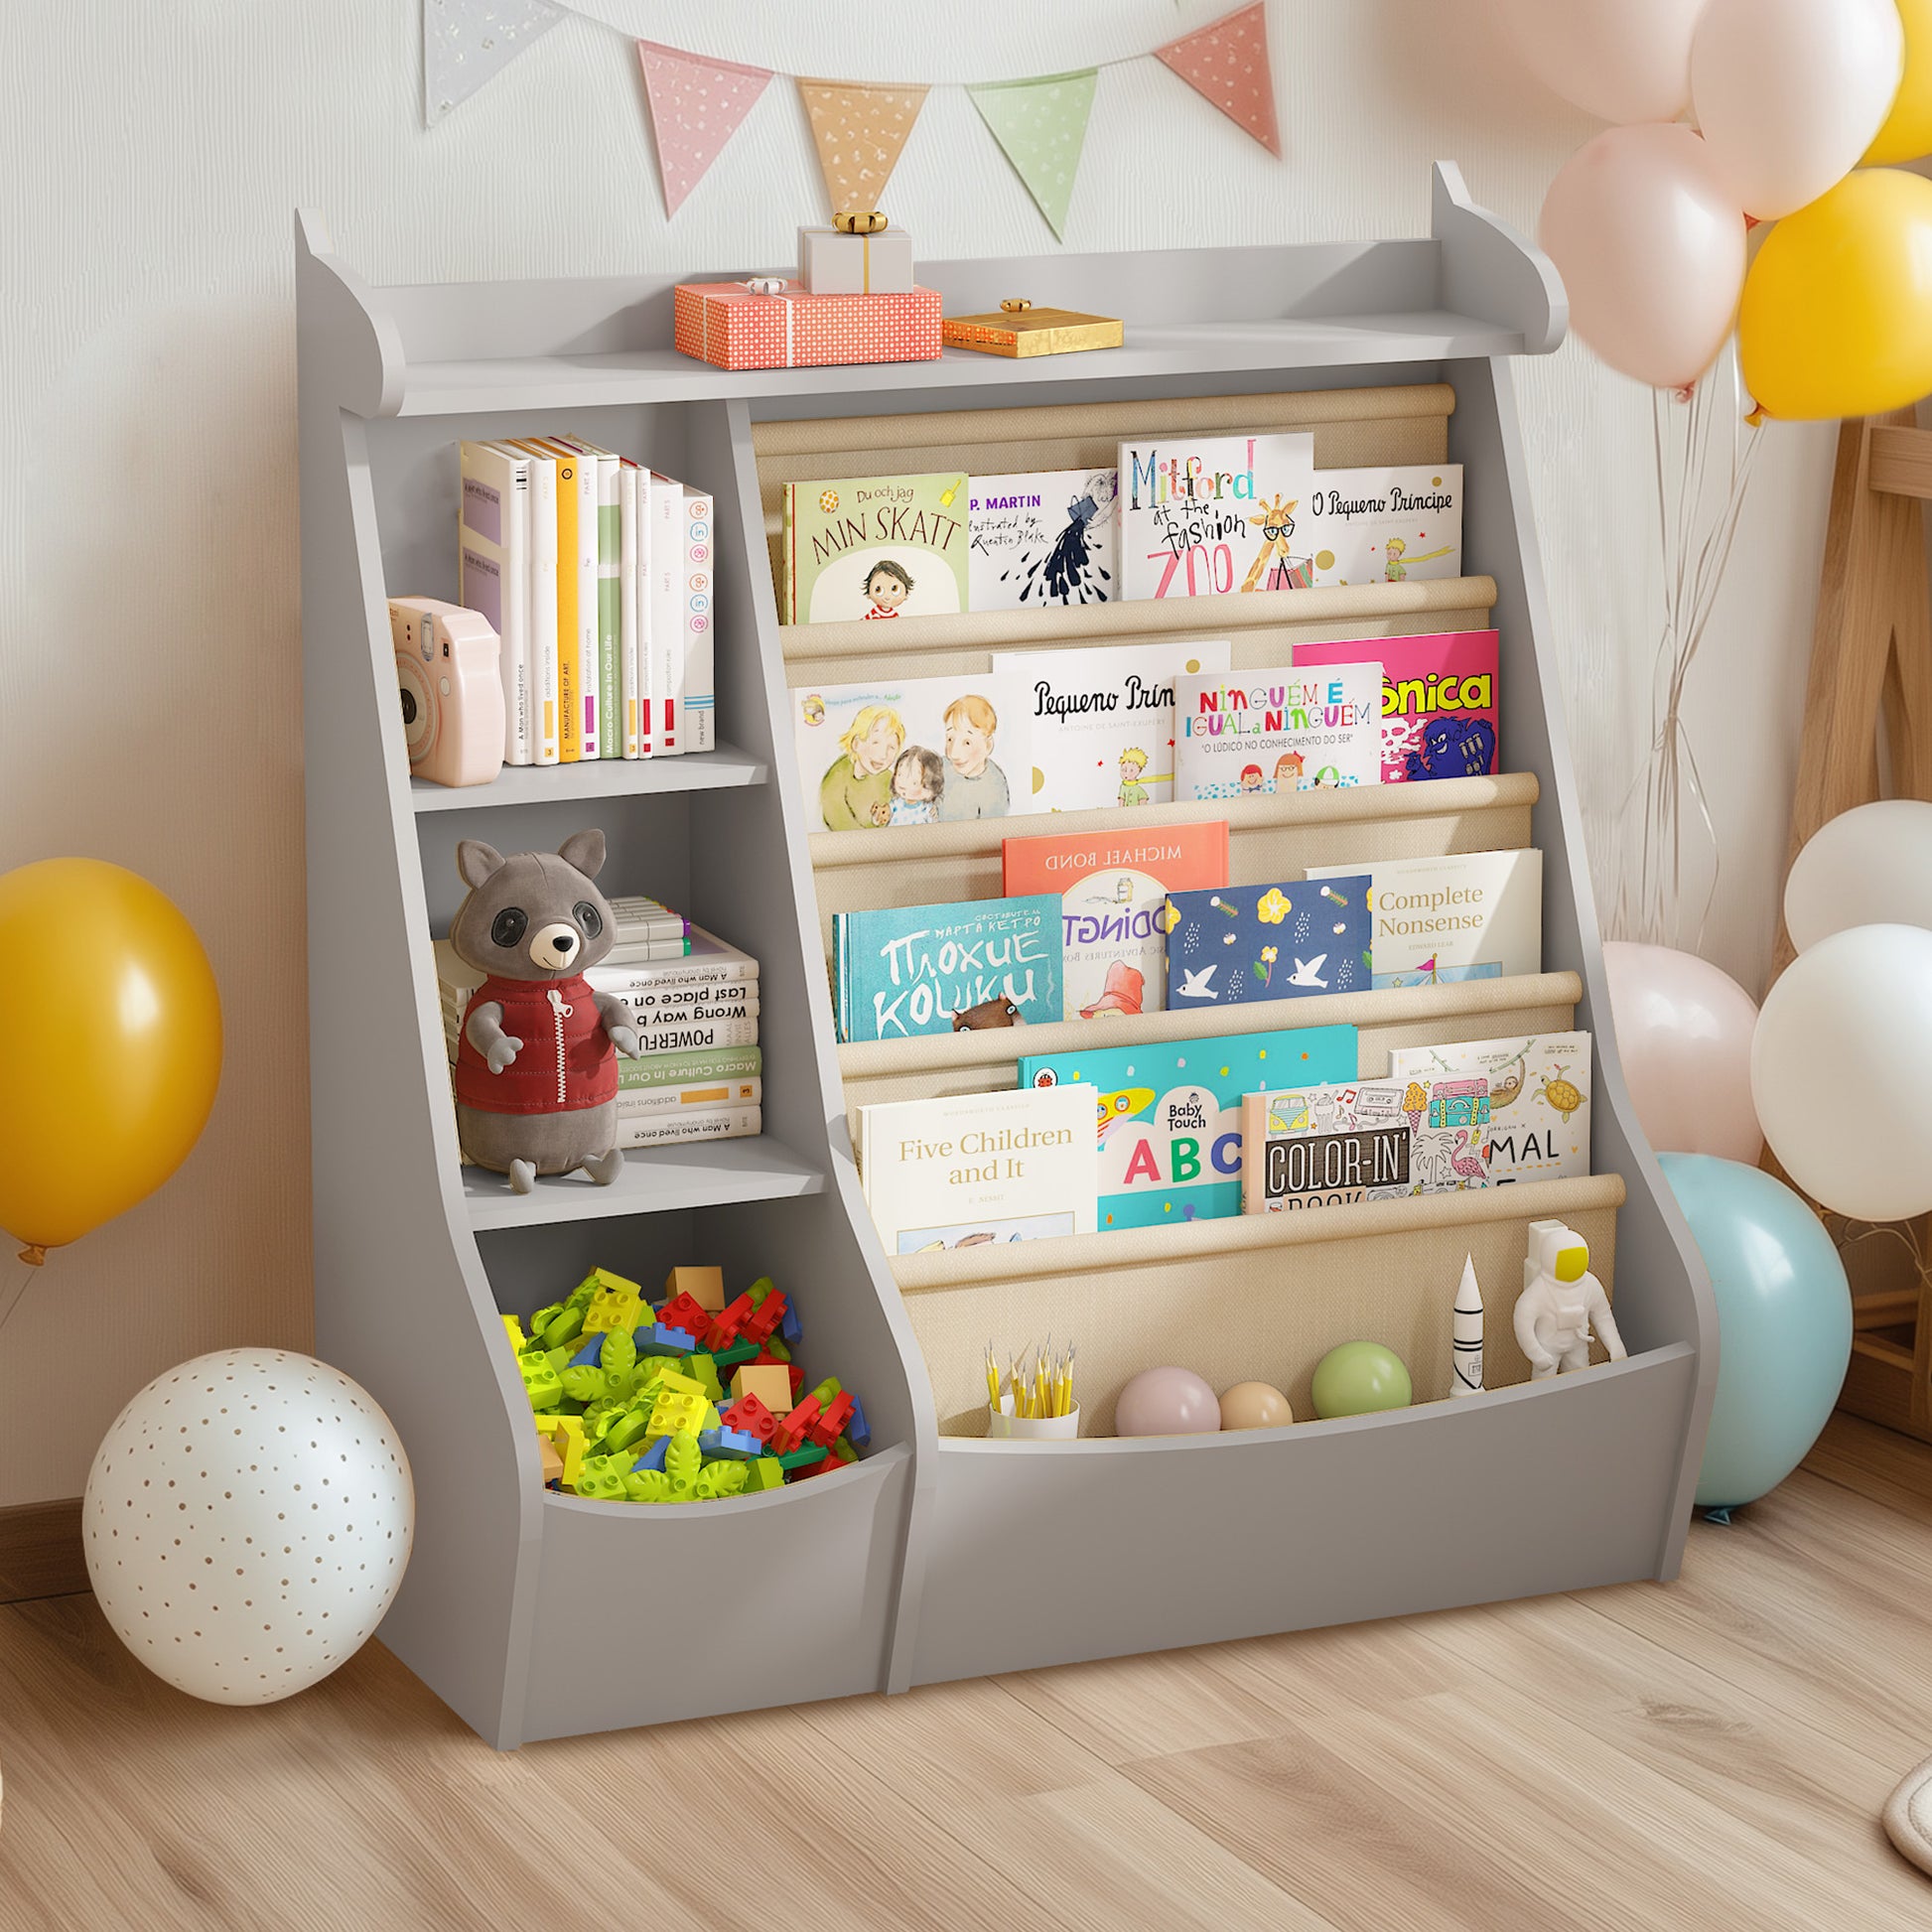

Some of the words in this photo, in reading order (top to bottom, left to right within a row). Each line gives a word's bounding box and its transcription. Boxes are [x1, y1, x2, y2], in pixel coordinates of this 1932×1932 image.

[1130, 439, 1257, 511] Mitford
[857, 487, 872, 503] Du
[874, 485, 895, 498] och
[891, 485, 914, 502] jag
[969, 498, 981, 510] P.
[986, 494, 1041, 510] MARTIN
[1153, 505, 1172, 526] at
[1180, 499, 1210, 519] the
[1312, 491, 1324, 516] O
[1328, 488, 1387, 521] Pequeno
[812, 513, 867, 565] MIN
[875, 506, 961, 552] SKATT
[1161, 510, 1247, 559] fashion
[1147, 543, 1234, 600] ZOO
[604, 634, 613, 650] Life
[604, 653, 613, 671] Our
[563, 677, 570, 687] OF
[605, 673, 613, 683] In
[605, 684, 614, 720] Culture
[1034, 680, 1119, 724] Pequeno
[1095, 722, 1107, 731] DE
[1185, 712, 1251, 738] IGUAL
[1252, 723, 1262, 735] a
[1245, 740, 1258, 751] NO
[1261, 735, 1321, 750] CONHECIMENTO
[1323, 735, 1336, 745] DO
[1379, 886, 1483, 911] Complete
[934, 922, 983, 939] МАРТА
[988, 916, 1041, 932] КЕТРО
[1379, 913, 1483, 936] Nonsense
[629, 980, 653, 989] once
[654, 977, 676, 987] lived
[677, 975, 697, 985] who
[699, 974, 719, 983] Man
[634, 996, 655, 1007] on
[661, 987, 709, 1006] place
[714, 987, 747, 1002] Last
[636, 1015, 647, 1027] b
[652, 1011, 687, 1025] way
[693, 1006, 747, 1021] Wrong
[638, 1029, 714, 1051] POWERFU
[669, 1066, 713, 1080] Culture
[716, 1060, 757, 1073] Macro
[627, 1072, 651, 1084] Our
[653, 1070, 665, 1080] In
[1170, 1102, 1203, 1118] Baby
[702, 1125, 721, 1134] Man
[1168, 1114, 1206, 1132] Touch
[657, 1129, 679, 1138] lived
[681, 1127, 700, 1136] who
[897, 1138, 953, 1163] Five
[959, 1126, 1073, 1156] Children
[1489, 1129, 1560, 1165] MAL
[949, 1160, 999, 1185] and
[1007, 1158, 1025, 1179] It
